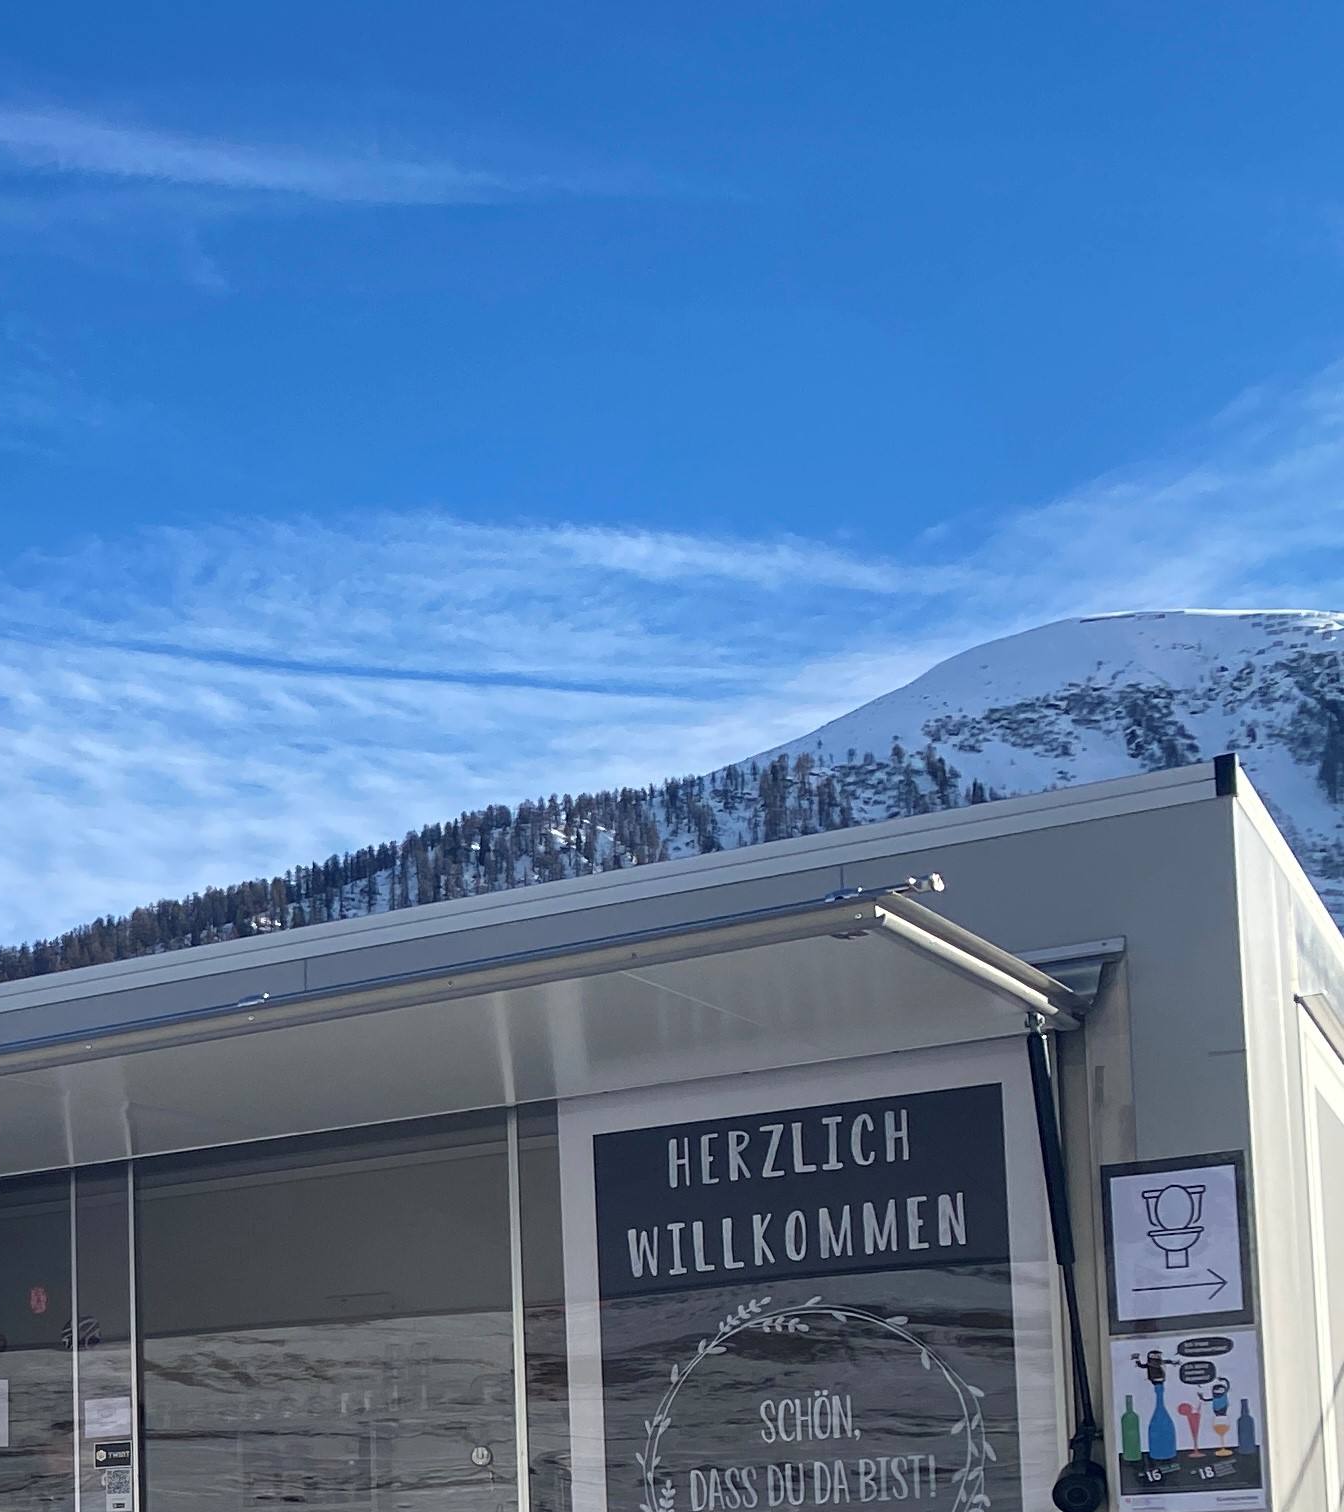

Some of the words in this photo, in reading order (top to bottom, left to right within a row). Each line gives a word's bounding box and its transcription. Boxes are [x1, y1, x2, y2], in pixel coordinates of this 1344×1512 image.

[668, 1109, 910, 1188] HERZLICH
[627, 1192, 967, 1278] WILLKOMMEN
[760, 1389, 861, 1443] SCHÖN,
[690, 1466, 758, 1512] DASS
[767, 1462, 805, 1507] DU
[814, 1459, 850, 1505] DA
[859, 1454, 936, 1502] BIST!
